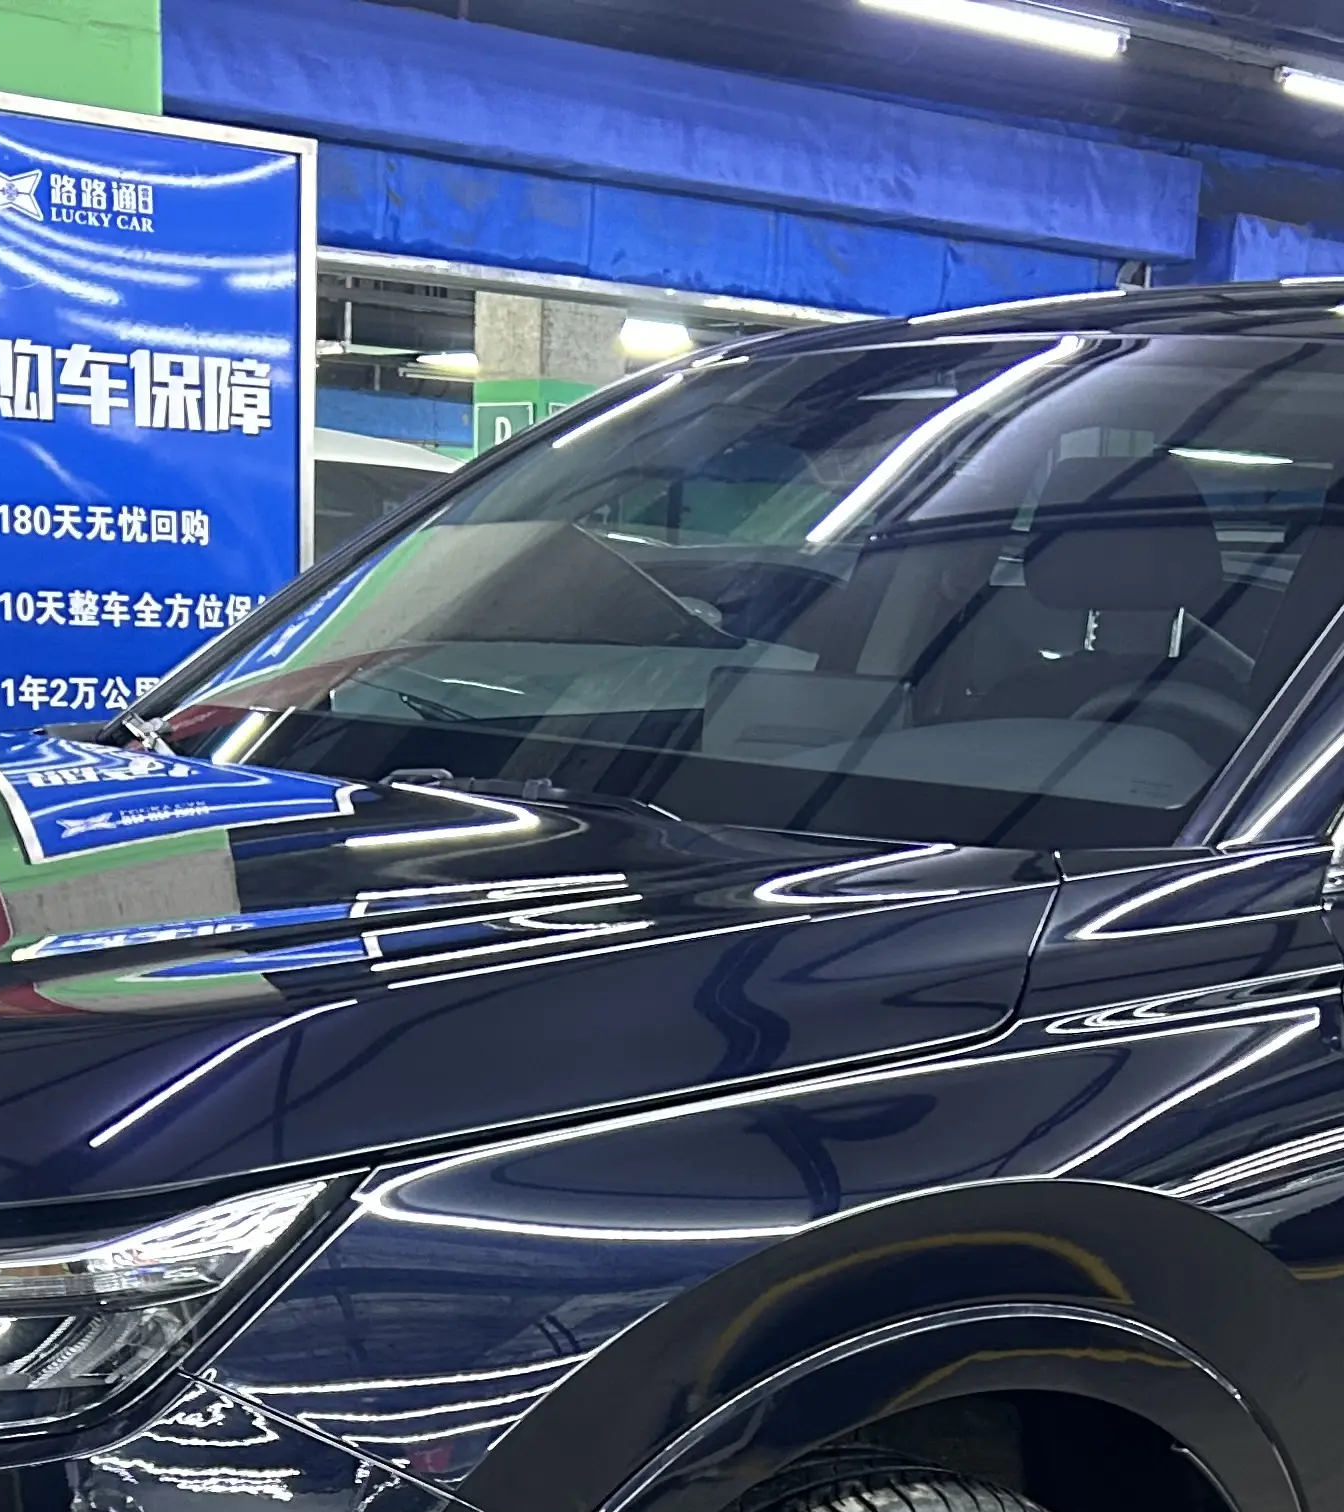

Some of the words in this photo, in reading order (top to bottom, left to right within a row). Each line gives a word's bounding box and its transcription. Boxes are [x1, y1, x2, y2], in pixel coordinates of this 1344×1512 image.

[50, 174, 138, 214] 路路通
[50, 207, 112, 228] LUCKY
[116, 215, 154, 233] CAR
